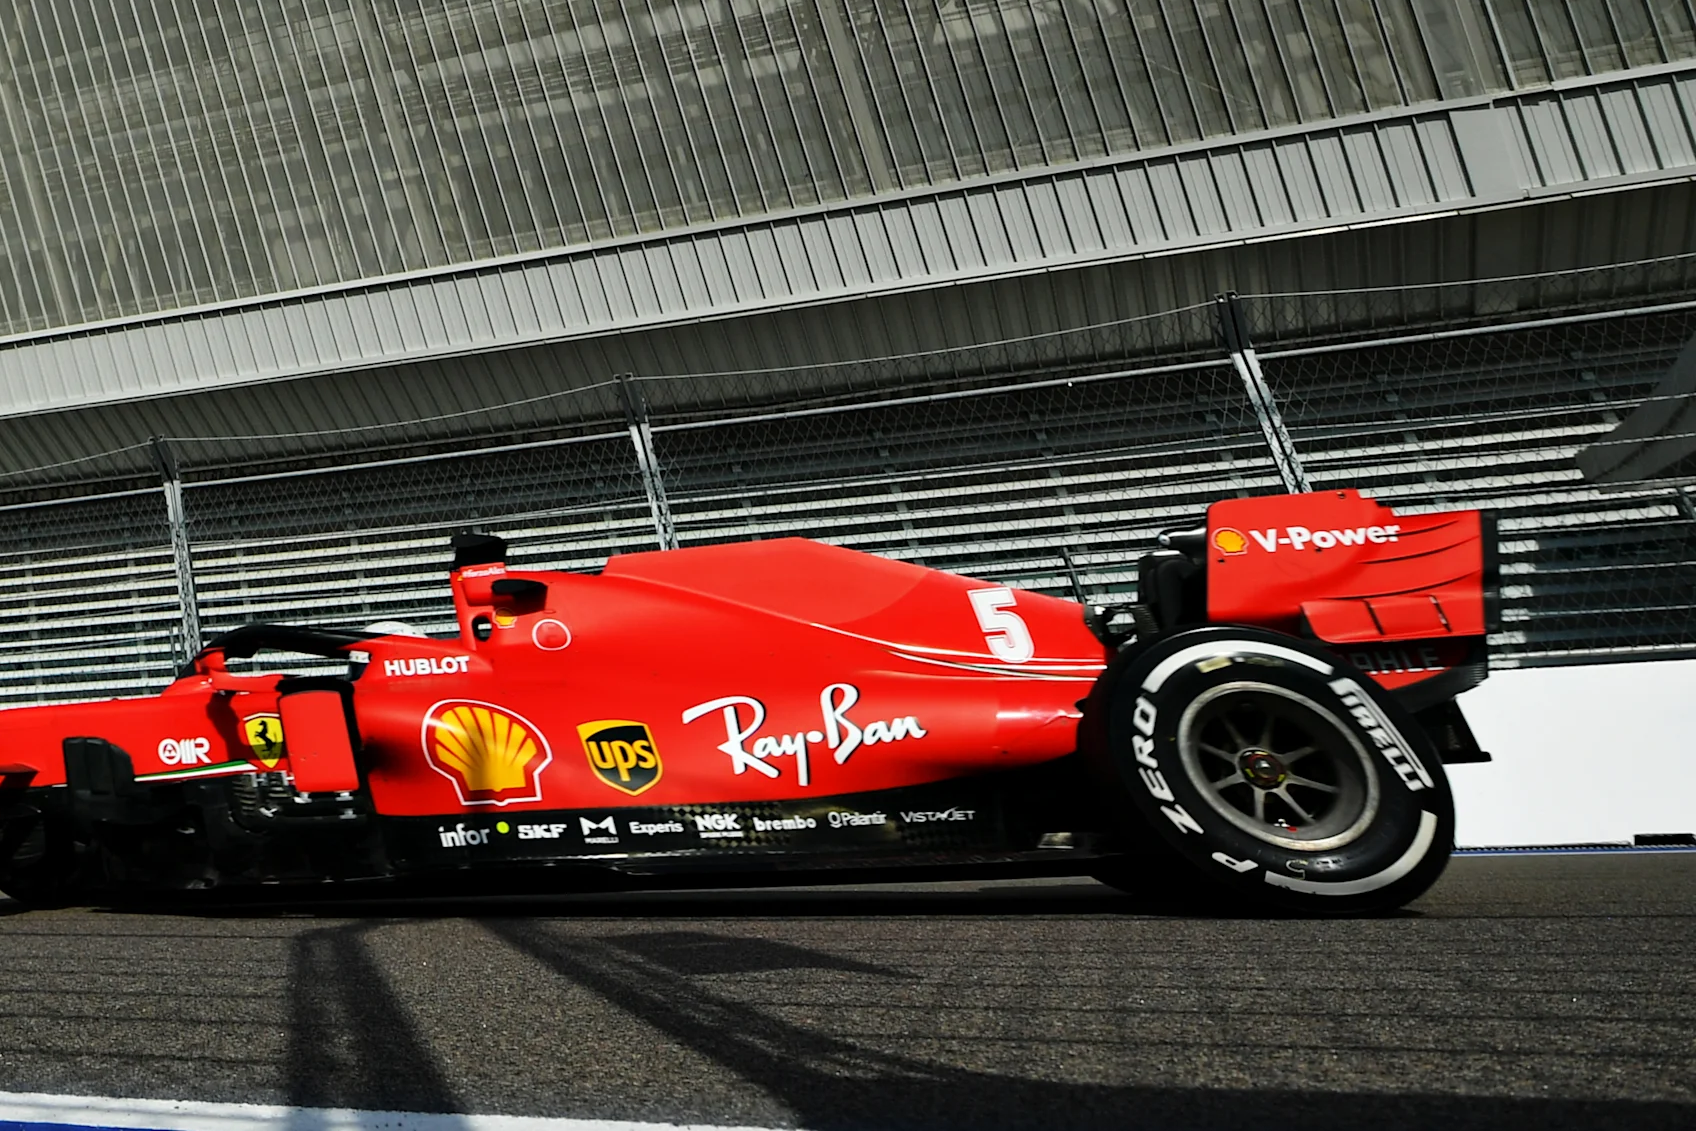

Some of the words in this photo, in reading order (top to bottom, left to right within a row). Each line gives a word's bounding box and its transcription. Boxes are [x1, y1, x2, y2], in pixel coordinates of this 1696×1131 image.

[1248, 524, 1401, 552] V-Power
[967, 586, 1035, 664] 5
[384, 656, 470, 676] HUBLOT
[1327, 677, 1435, 791] PIRELLI
[588, 739, 656, 782] ups
[1132, 695, 1204, 834] ZERO
[518, 824, 567, 839] SKF
[629, 820, 684, 836] Experis
[694, 813, 741, 831] NGK
[753, 816, 817, 831] brembo
[438, 823, 490, 848] infor
